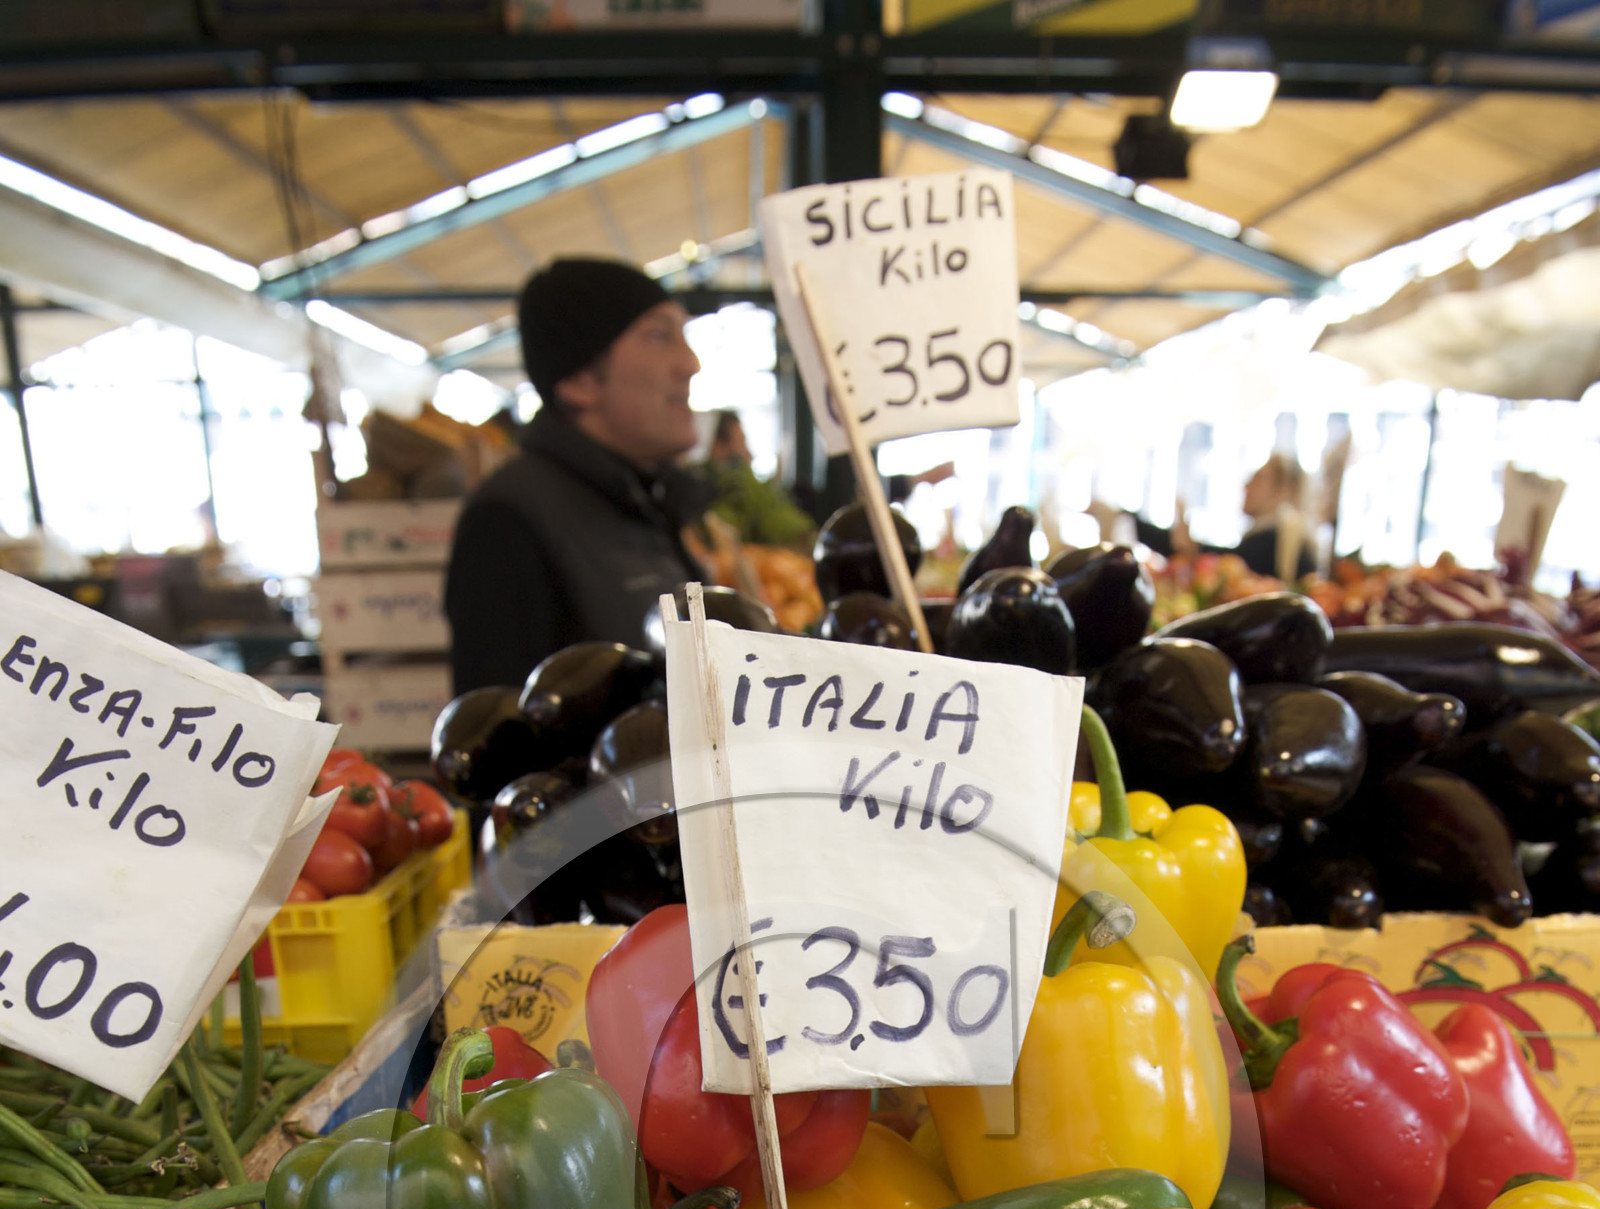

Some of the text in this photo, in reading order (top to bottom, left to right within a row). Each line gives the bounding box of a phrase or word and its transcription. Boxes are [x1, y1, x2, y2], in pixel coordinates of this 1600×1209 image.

[880, 242, 968, 286] Kilo
[37, 737, 186, 847] Kilo
[839, 750, 994, 834] Kilo
[0, 892, 163, 1049] .00
[485, 969, 544, 992] ITALIA
